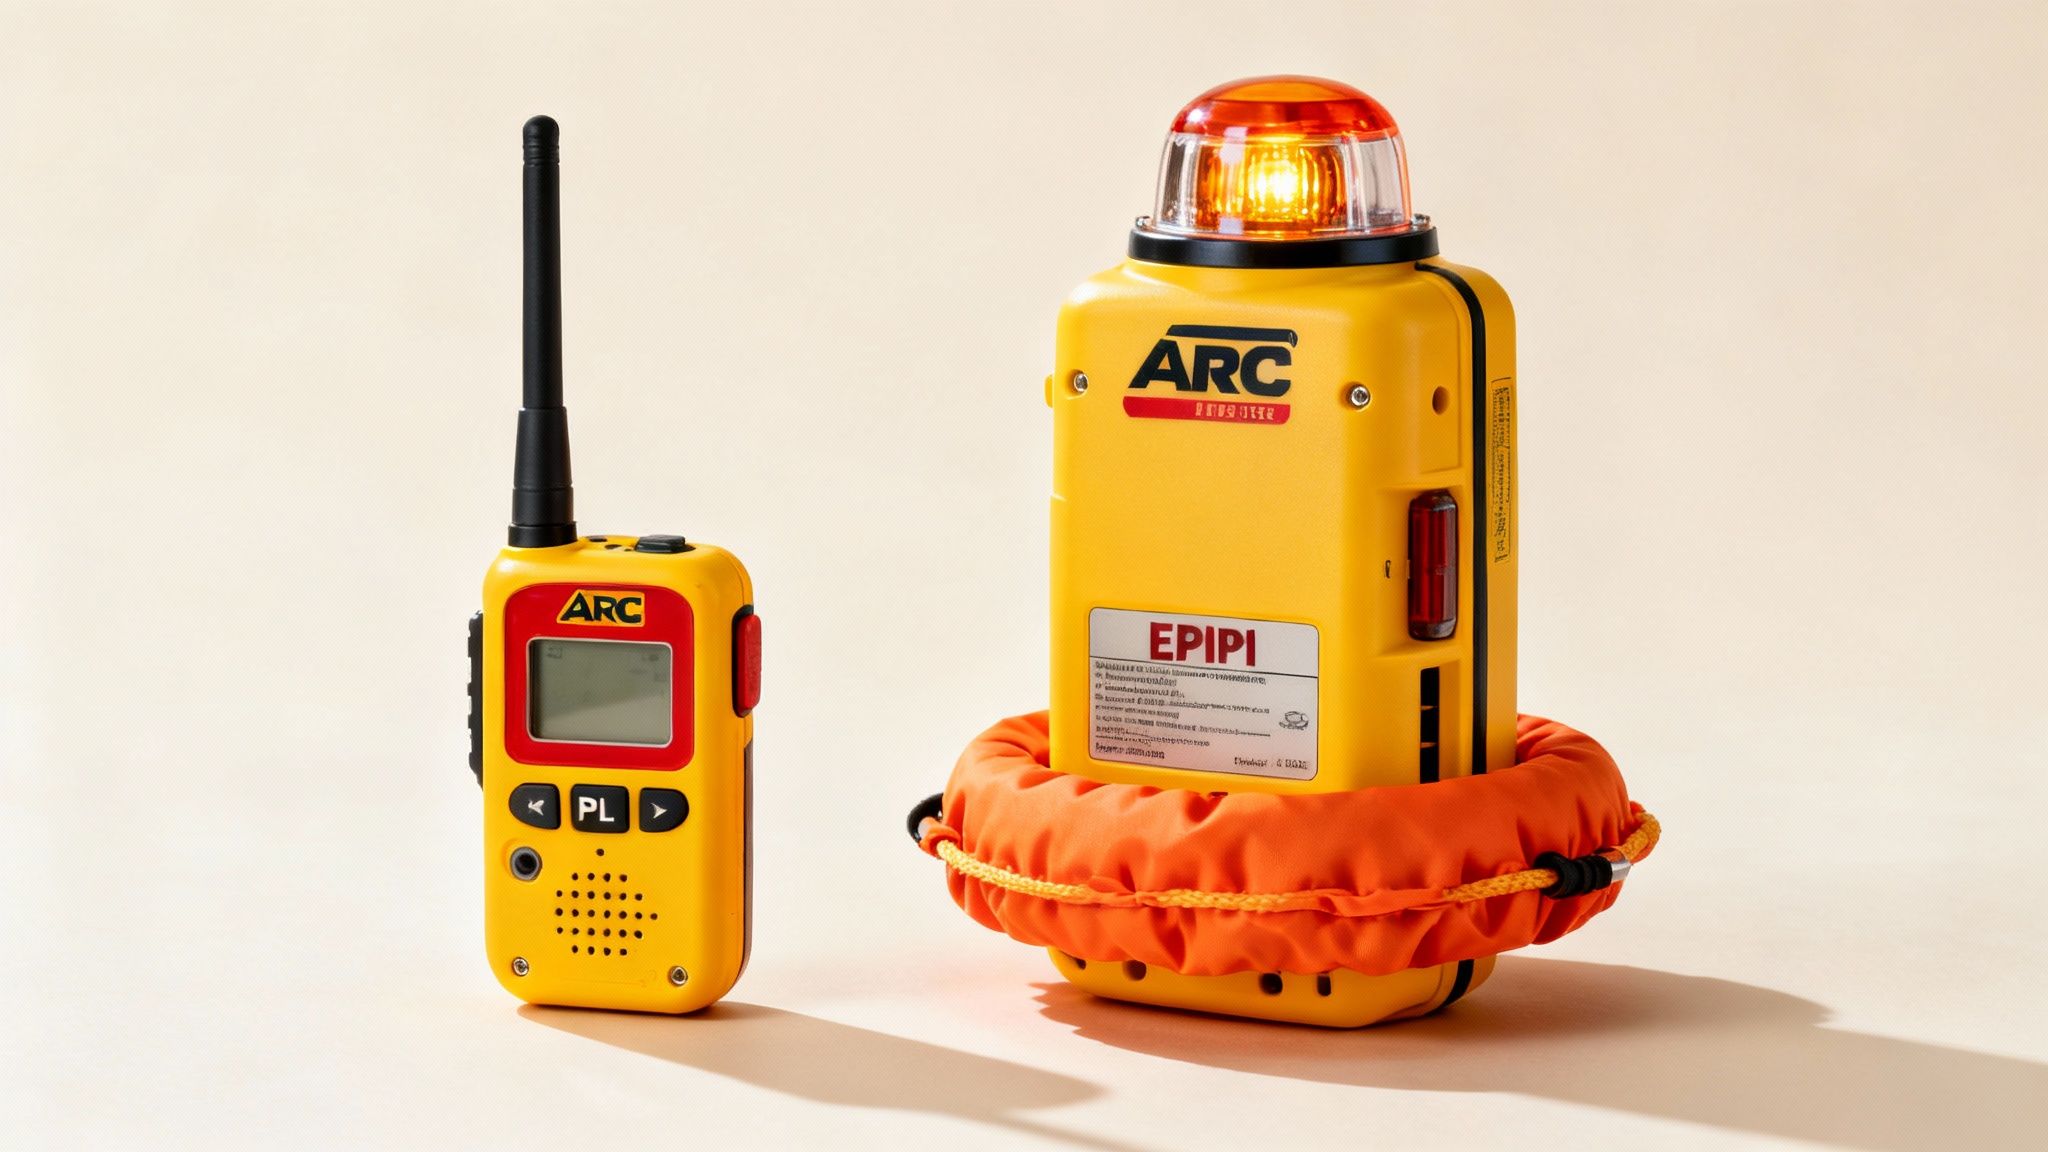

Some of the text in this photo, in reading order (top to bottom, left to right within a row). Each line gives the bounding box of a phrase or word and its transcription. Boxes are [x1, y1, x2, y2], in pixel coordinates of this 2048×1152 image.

[1128, 338, 1292, 397] ARC
[560, 592, 642, 624] ARC
[1150, 622, 1256, 667] EPIPI
[578, 796, 615, 822] PL
